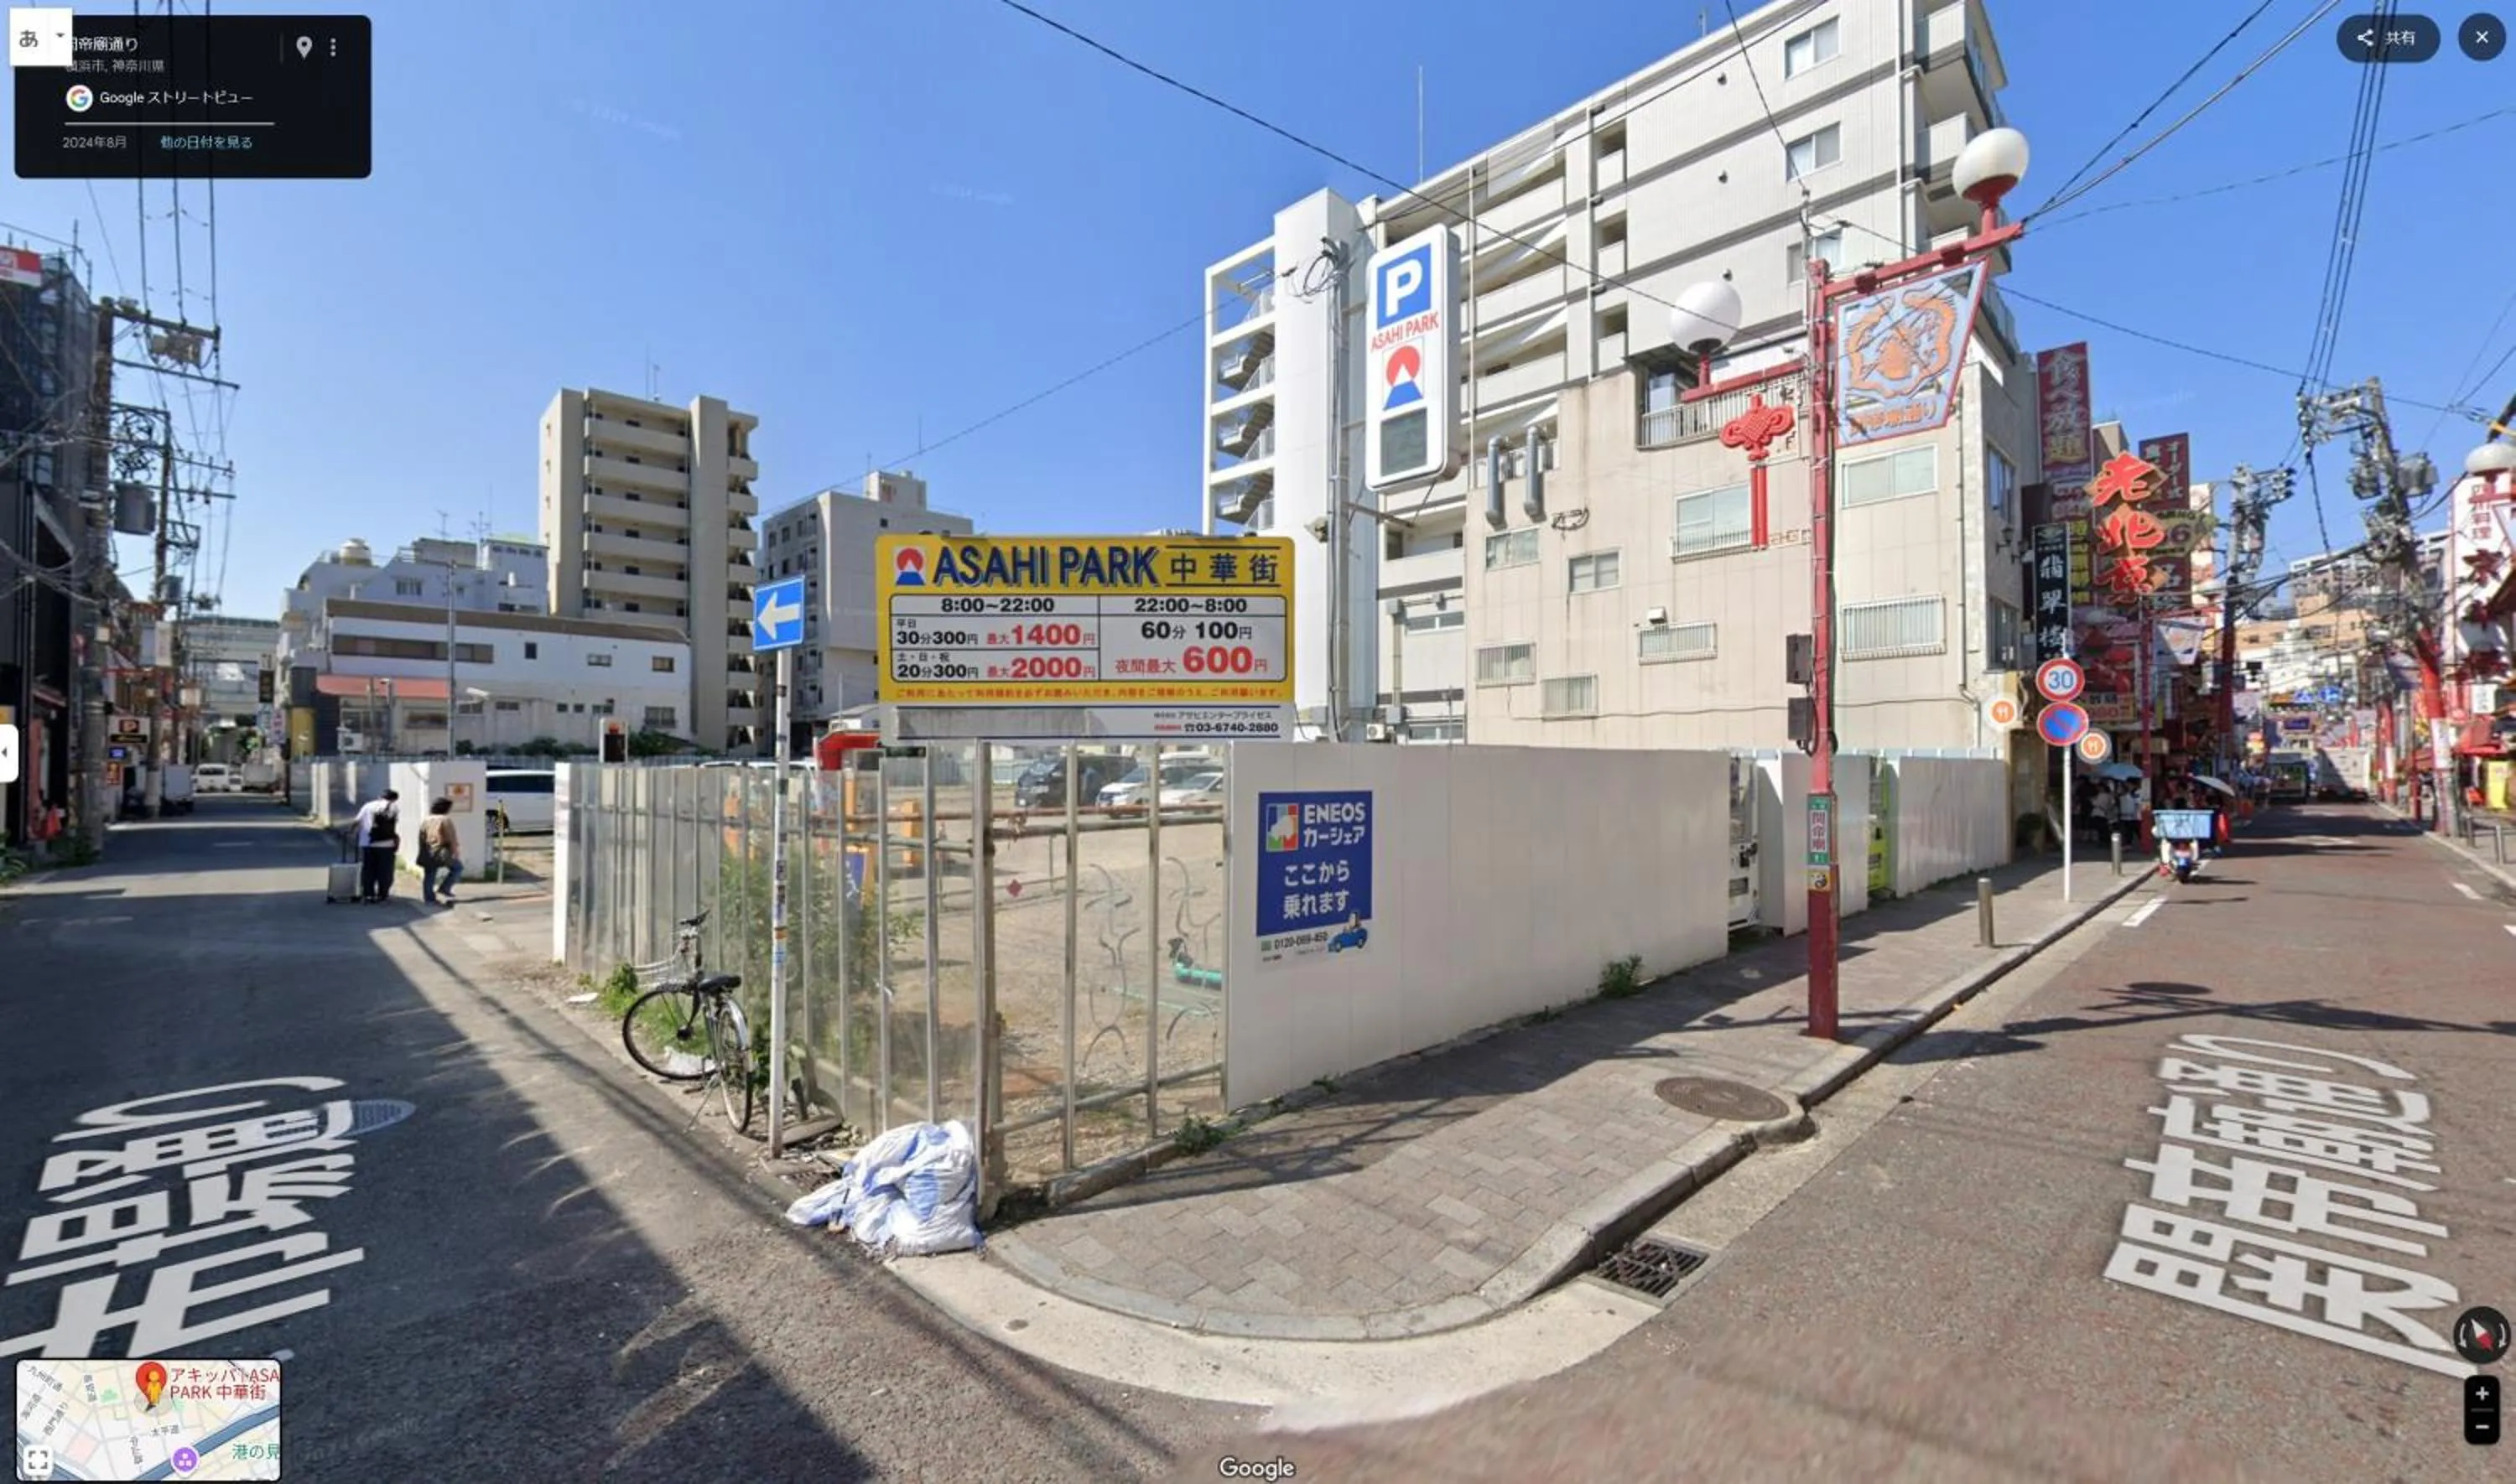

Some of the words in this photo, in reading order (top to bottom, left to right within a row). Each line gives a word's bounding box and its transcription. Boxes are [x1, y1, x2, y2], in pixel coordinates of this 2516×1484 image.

[1385, 258, 1423, 319] P
[1370, 325, 1403, 351] ASAHI
[1406, 311, 1440, 340] PARK
[932, 545, 1052, 588] ASAHI
[1058, 545, 1163, 587] PARK
[1169, 551, 1279, 583] 中華街
[897, 618, 917, 629] 平日
[2048, 670, 2075, 690] 30
[1303, 802, 1366, 825] ENEOS
[1302, 825, 1366, 848] カーシェア
[1284, 859, 1350, 887] ここから
[1282, 889, 1350, 921] 乗れます
